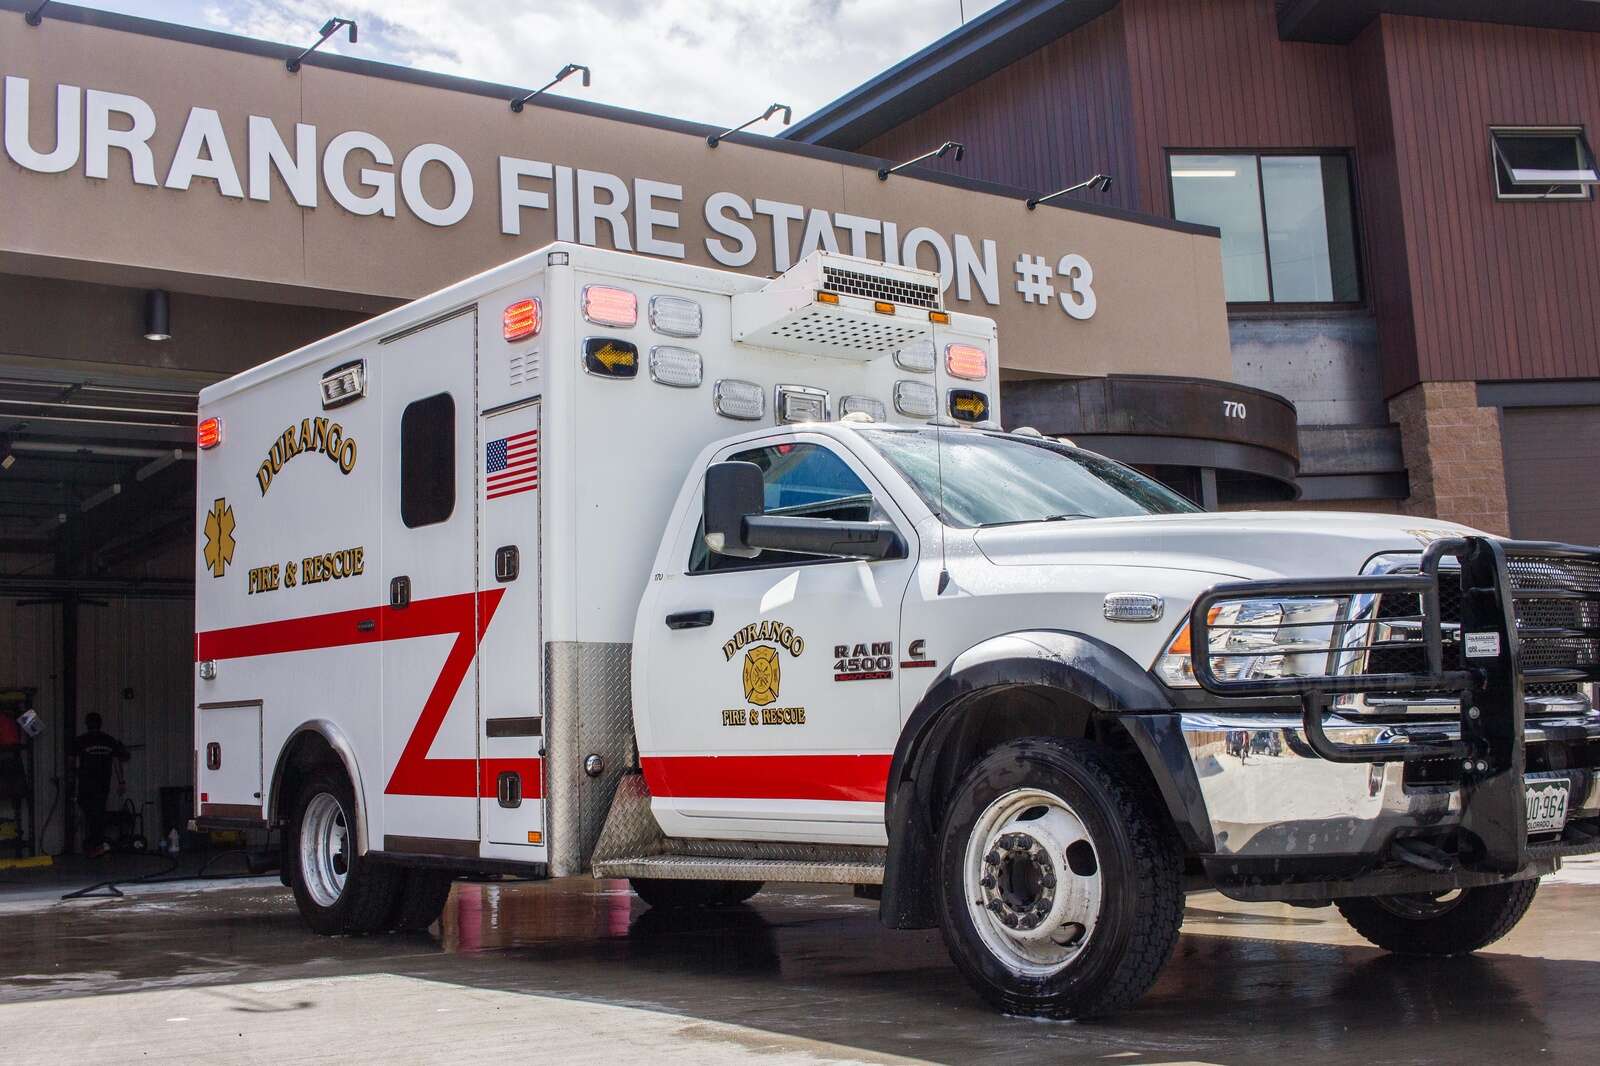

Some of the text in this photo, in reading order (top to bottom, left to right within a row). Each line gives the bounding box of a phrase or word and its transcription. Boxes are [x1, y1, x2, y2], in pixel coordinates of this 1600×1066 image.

[498, 156, 686, 259] FIRE
[704, 192, 1000, 305] STATION
[1014, 253, 1098, 320] #3
[1223, 400, 1246, 419] 770
[256, 416, 357, 497] DURANGO
[248, 546, 365, 594] FIRE & RESCUE
[722, 620, 804, 662] DURANGO
[834, 641, 893, 658] RAM
[833, 656, 893, 672] 4500
[722, 707, 806, 726] FIRE & RESCUE
